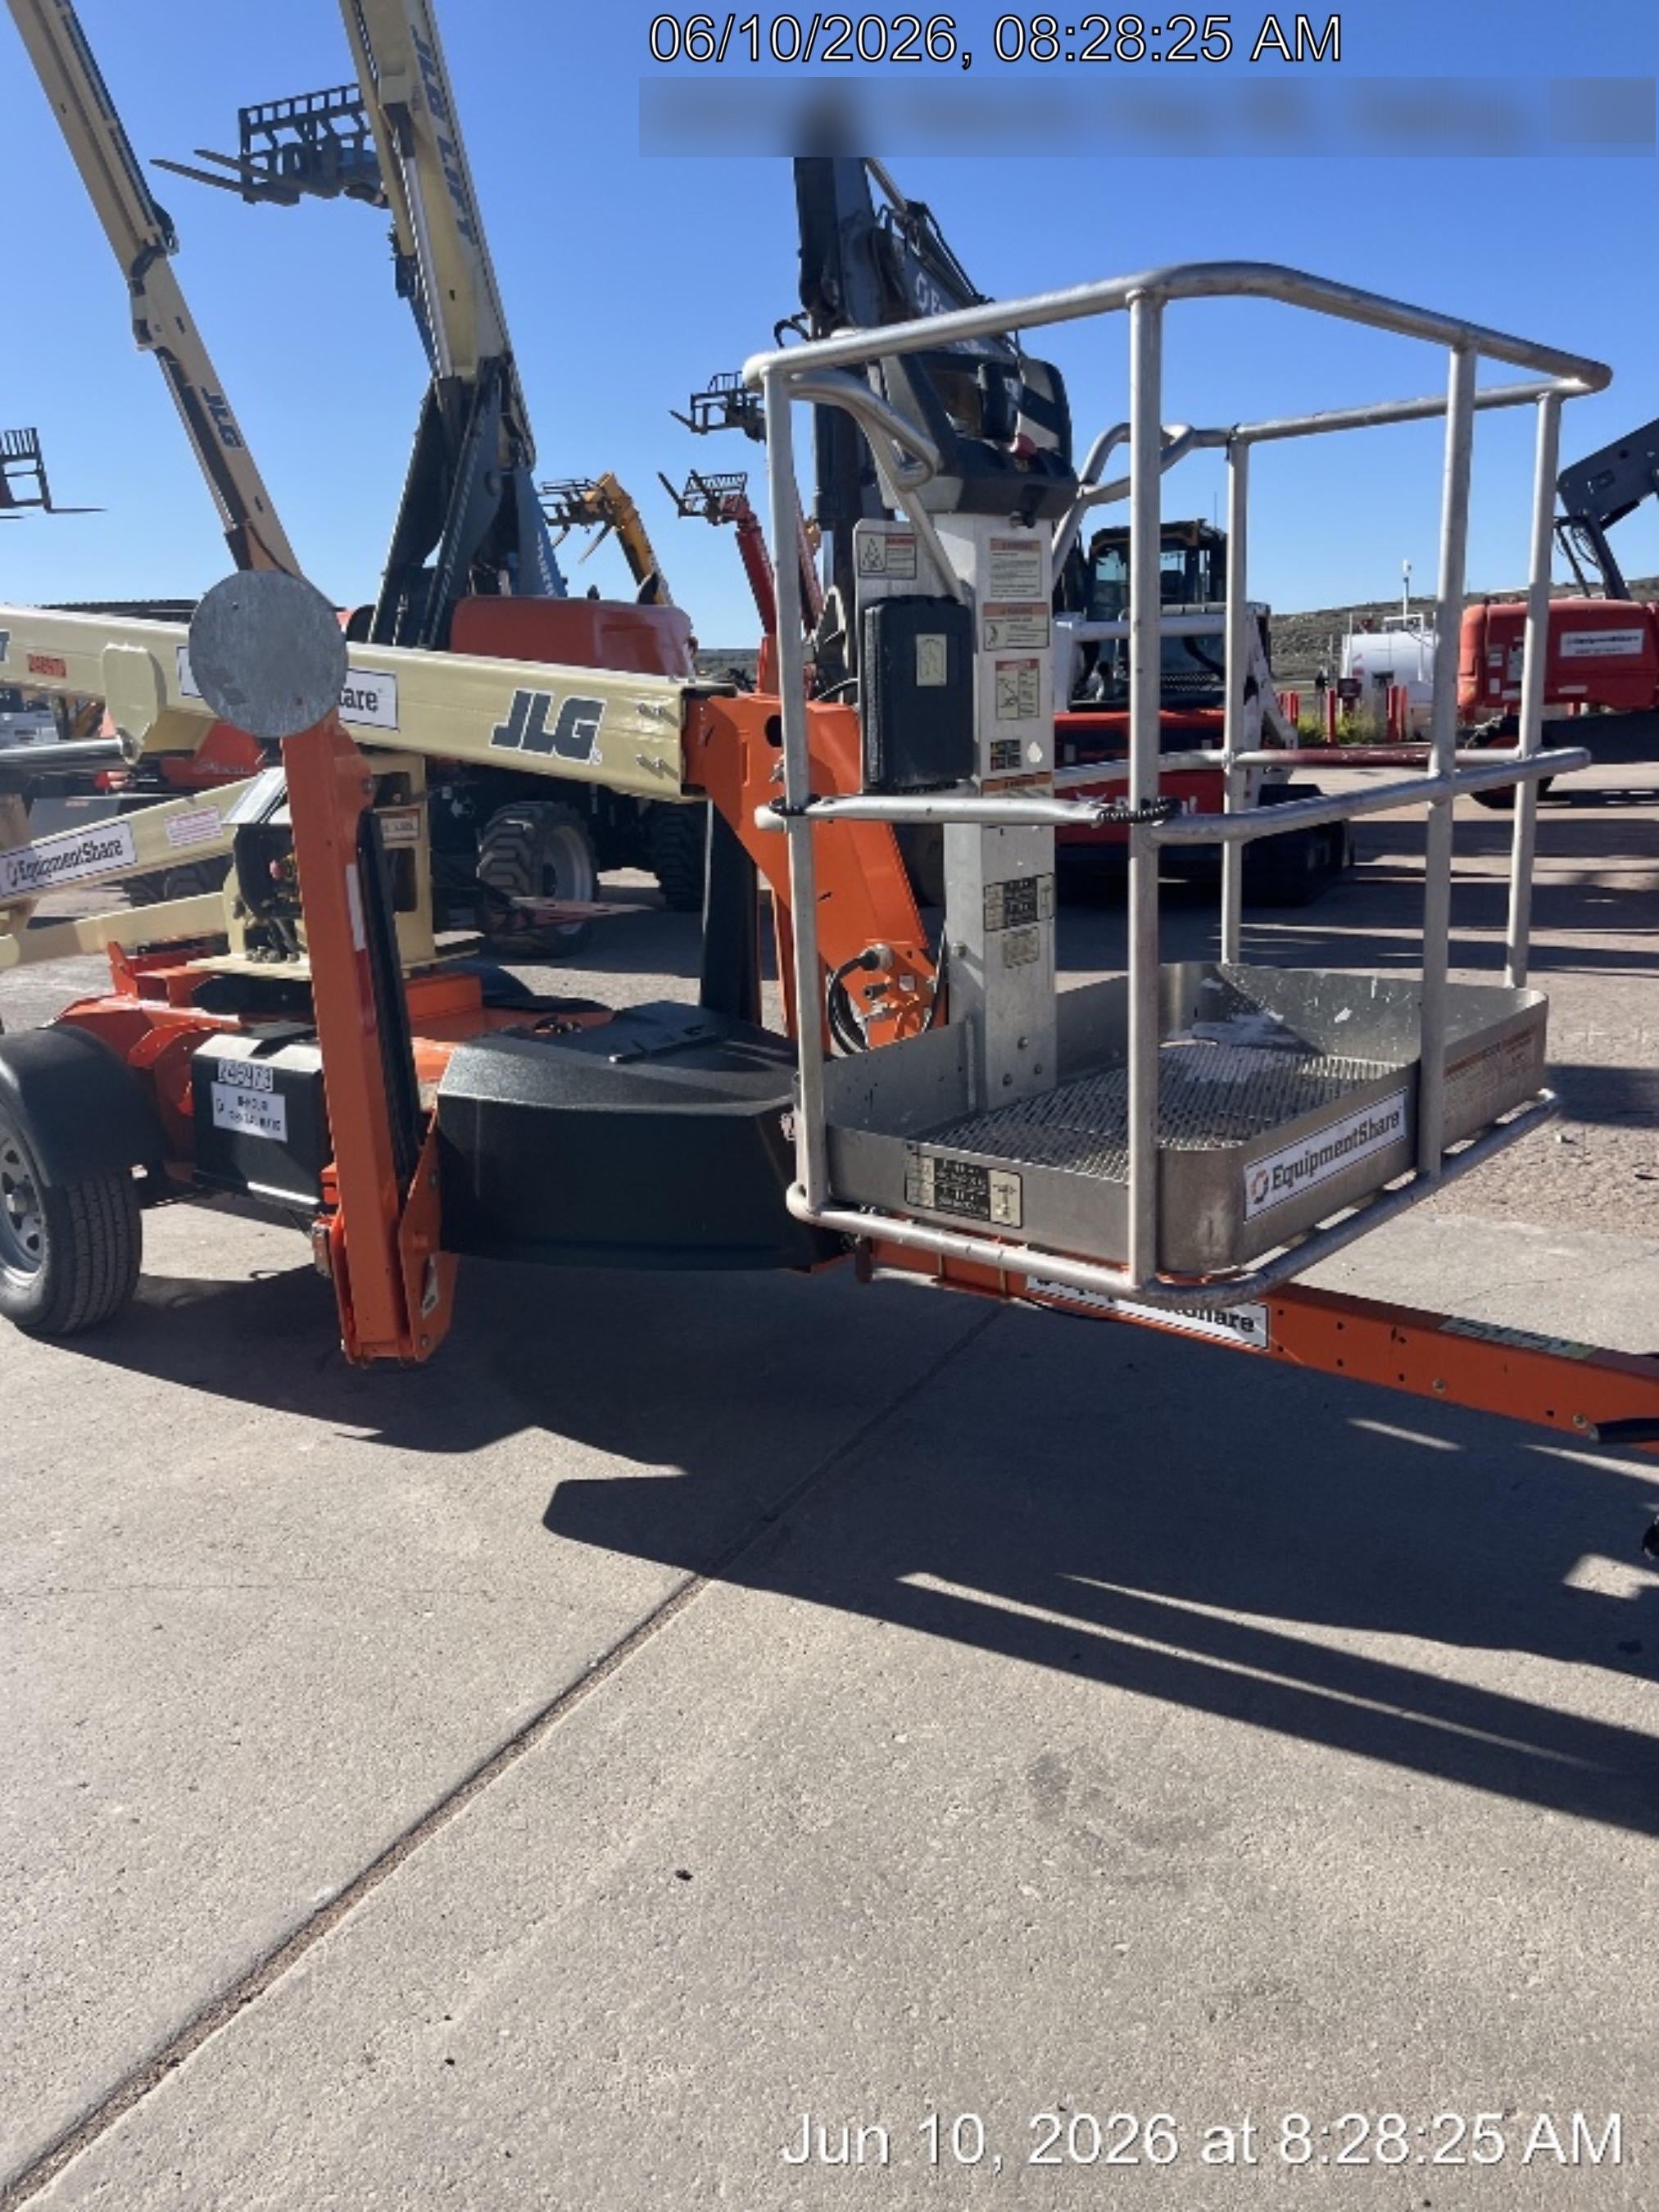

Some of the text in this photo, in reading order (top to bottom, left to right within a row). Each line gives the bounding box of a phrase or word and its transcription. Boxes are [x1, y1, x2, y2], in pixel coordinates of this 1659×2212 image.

[410, 25, 445, 120] JLG
[201, 386, 242, 448] JLG
[490, 689, 607, 764] JLG
[19, 838, 123, 883] EquipmentShare
[1271, 1109, 1400, 1190] EquipmentShare
